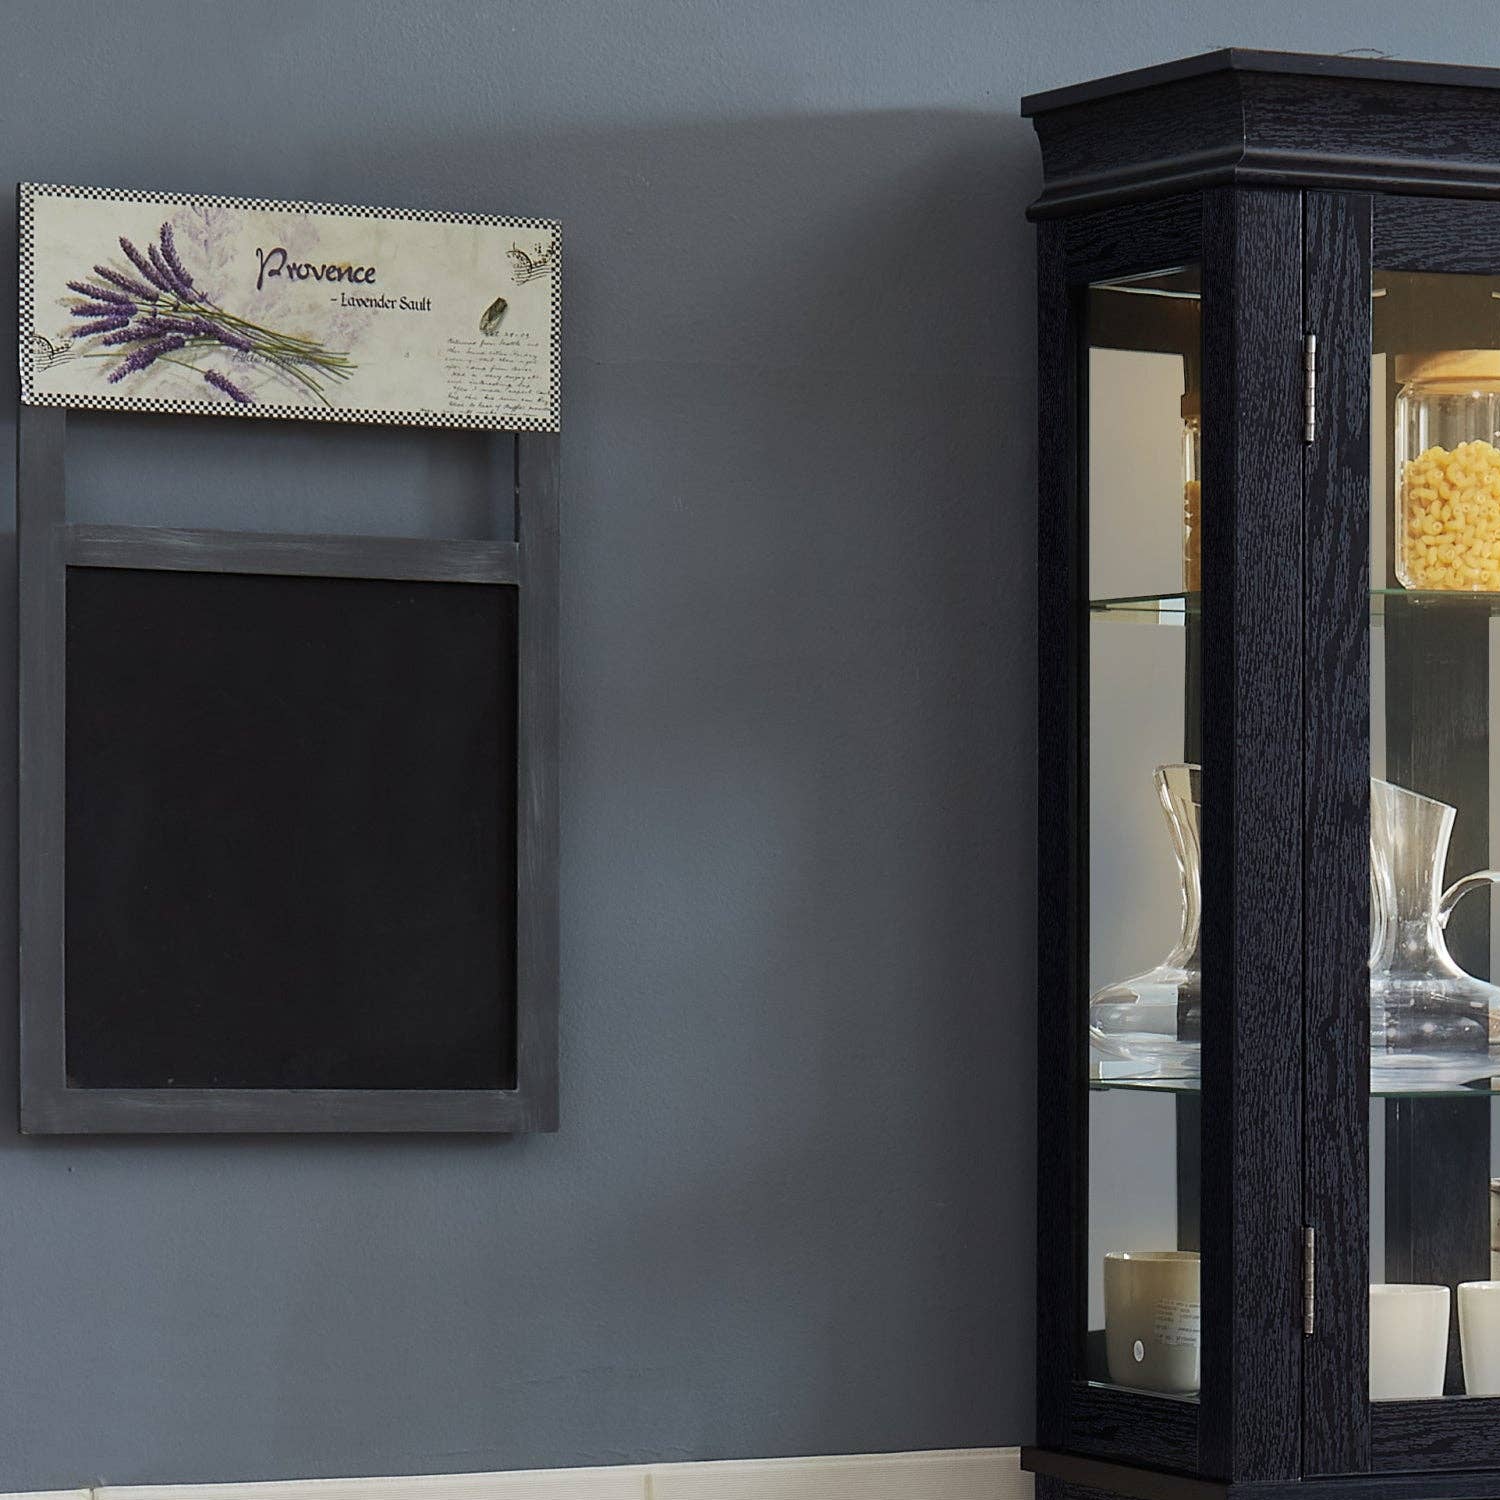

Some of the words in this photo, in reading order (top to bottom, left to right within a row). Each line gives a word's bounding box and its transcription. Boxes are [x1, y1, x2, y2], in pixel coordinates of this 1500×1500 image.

[255, 247, 376, 290] Provence
[341, 292, 397, 309] Lavender
[399, 295, 432, 312] Sault
